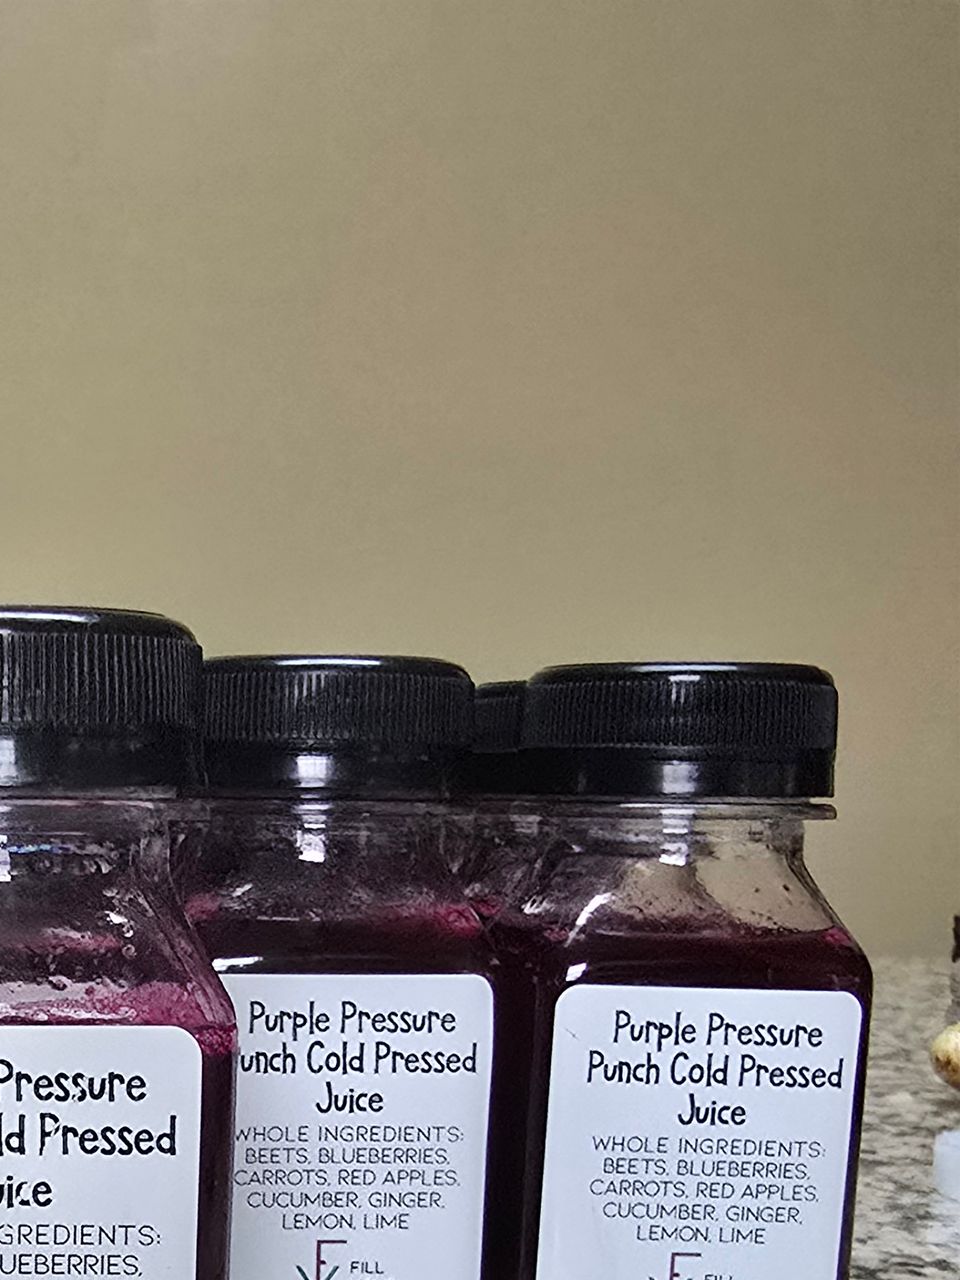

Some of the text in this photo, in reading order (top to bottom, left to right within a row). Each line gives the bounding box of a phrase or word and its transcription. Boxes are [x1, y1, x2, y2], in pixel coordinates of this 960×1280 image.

[249, 1001, 456, 1041] Purple Pressure
[613, 1010, 823, 1052] Purple Pressure
[240, 1040, 477, 1075] unch Cold Pressed
[587, 1050, 844, 1089] Punch Cold Pressed
[315, 1081, 383, 1114] Juice
[678, 1093, 746, 1126] Juice
[39, 1113, 177, 1156] Pressed
[318, 1125, 464, 1143] INGREDIENTS:
[592, 1136, 826, 1158] WHOLE INGREDIENTS:
[338, 1169, 376, 1186] RED
[696, 1181, 735, 1199] RED
[364, 1213, 410, 1230] LIME
[719, 1227, 766, 1244] LIME
[350, 1261, 384, 1274] FILL
